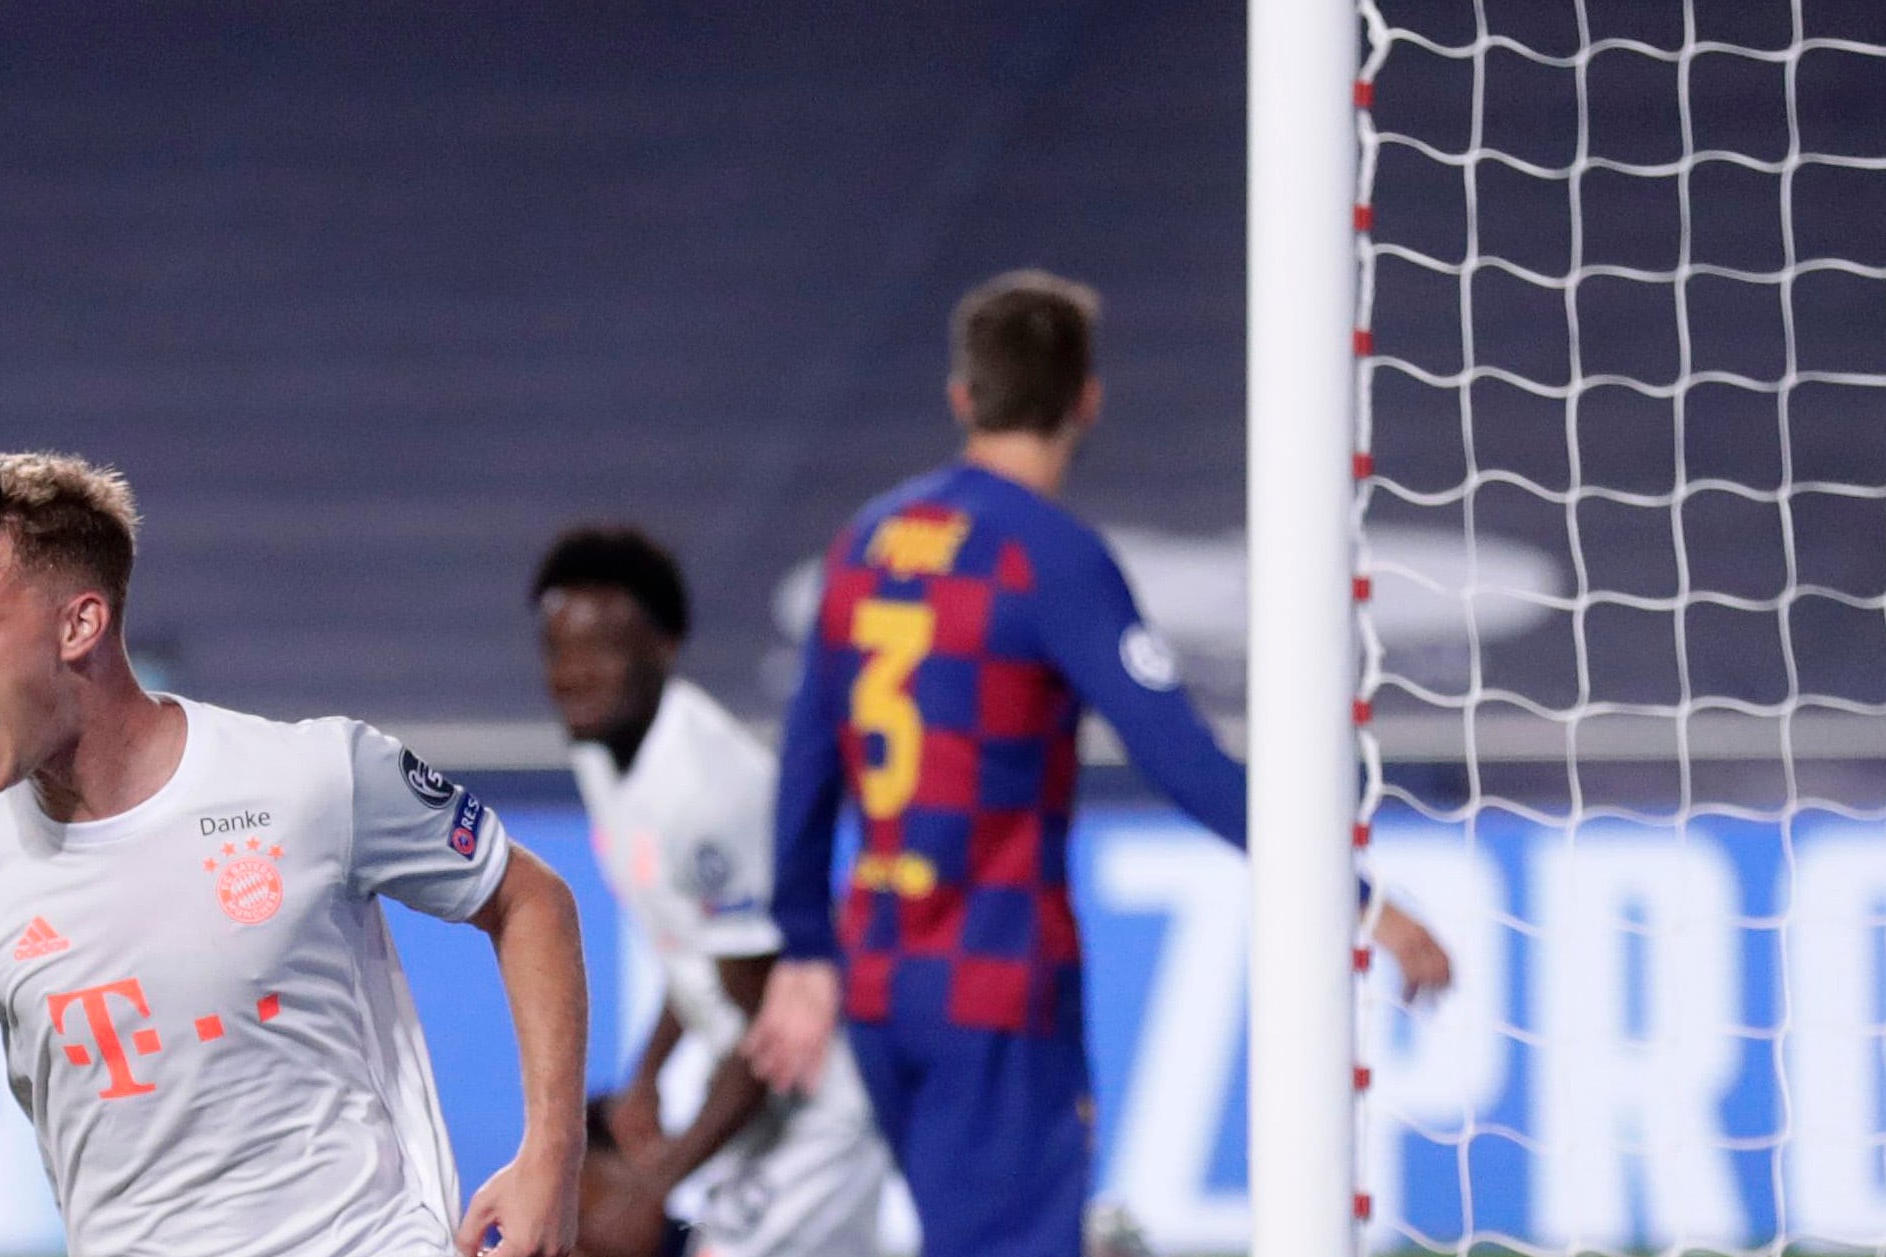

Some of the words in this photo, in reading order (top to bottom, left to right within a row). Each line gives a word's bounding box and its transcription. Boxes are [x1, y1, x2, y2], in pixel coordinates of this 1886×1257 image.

[849, 600, 937, 820] 3
[200, 810, 271, 836] Danke
[460, 794, 481, 830] RES
